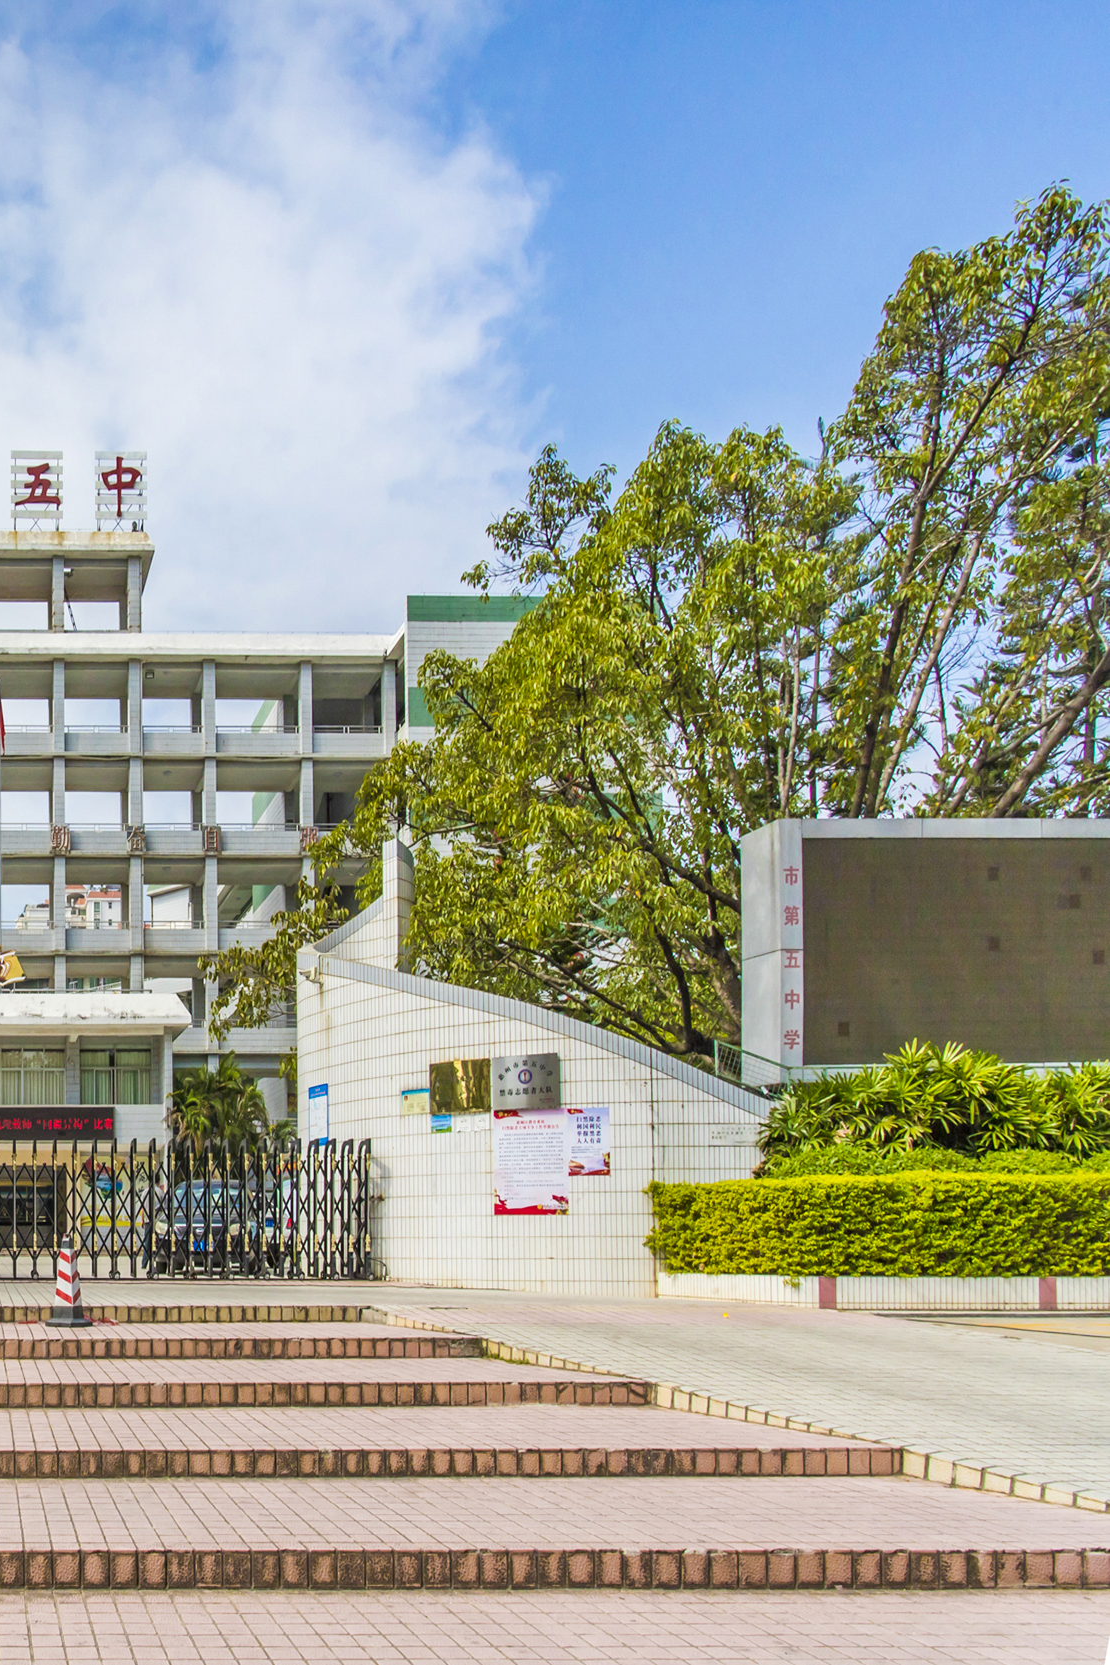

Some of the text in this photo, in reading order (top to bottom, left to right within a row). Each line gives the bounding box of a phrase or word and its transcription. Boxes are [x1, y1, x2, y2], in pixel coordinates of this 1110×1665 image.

[783, 866, 801, 1050] 市第五中学
